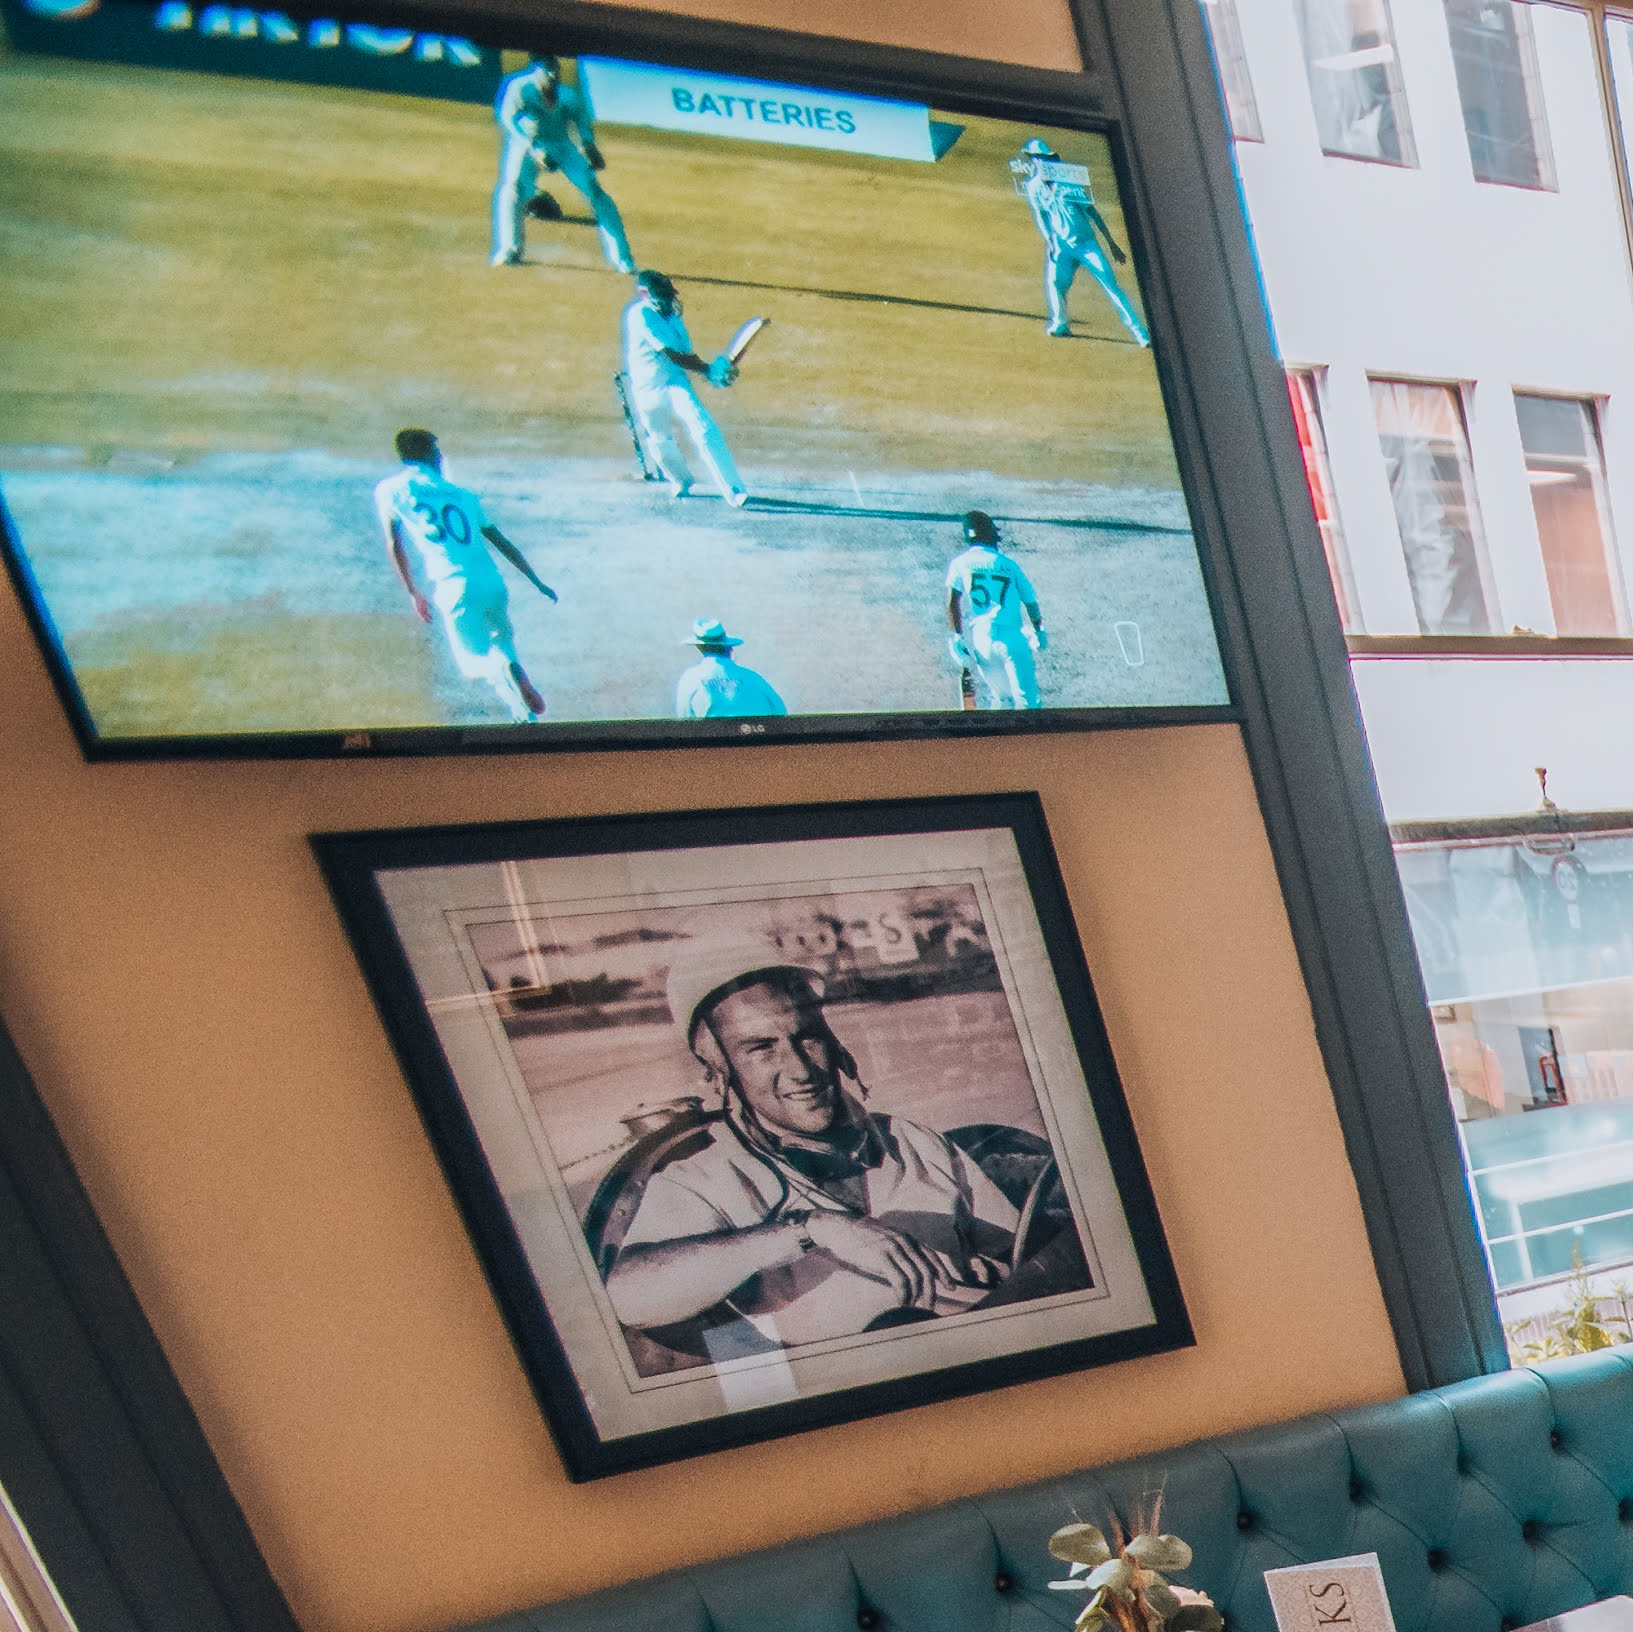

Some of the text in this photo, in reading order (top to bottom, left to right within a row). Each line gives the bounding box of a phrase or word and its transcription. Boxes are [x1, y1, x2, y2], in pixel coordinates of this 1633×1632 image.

[671, 87, 857, 134] BATTERIES
[412, 503, 471, 545] 30
[970, 573, 1011, 608] 57
